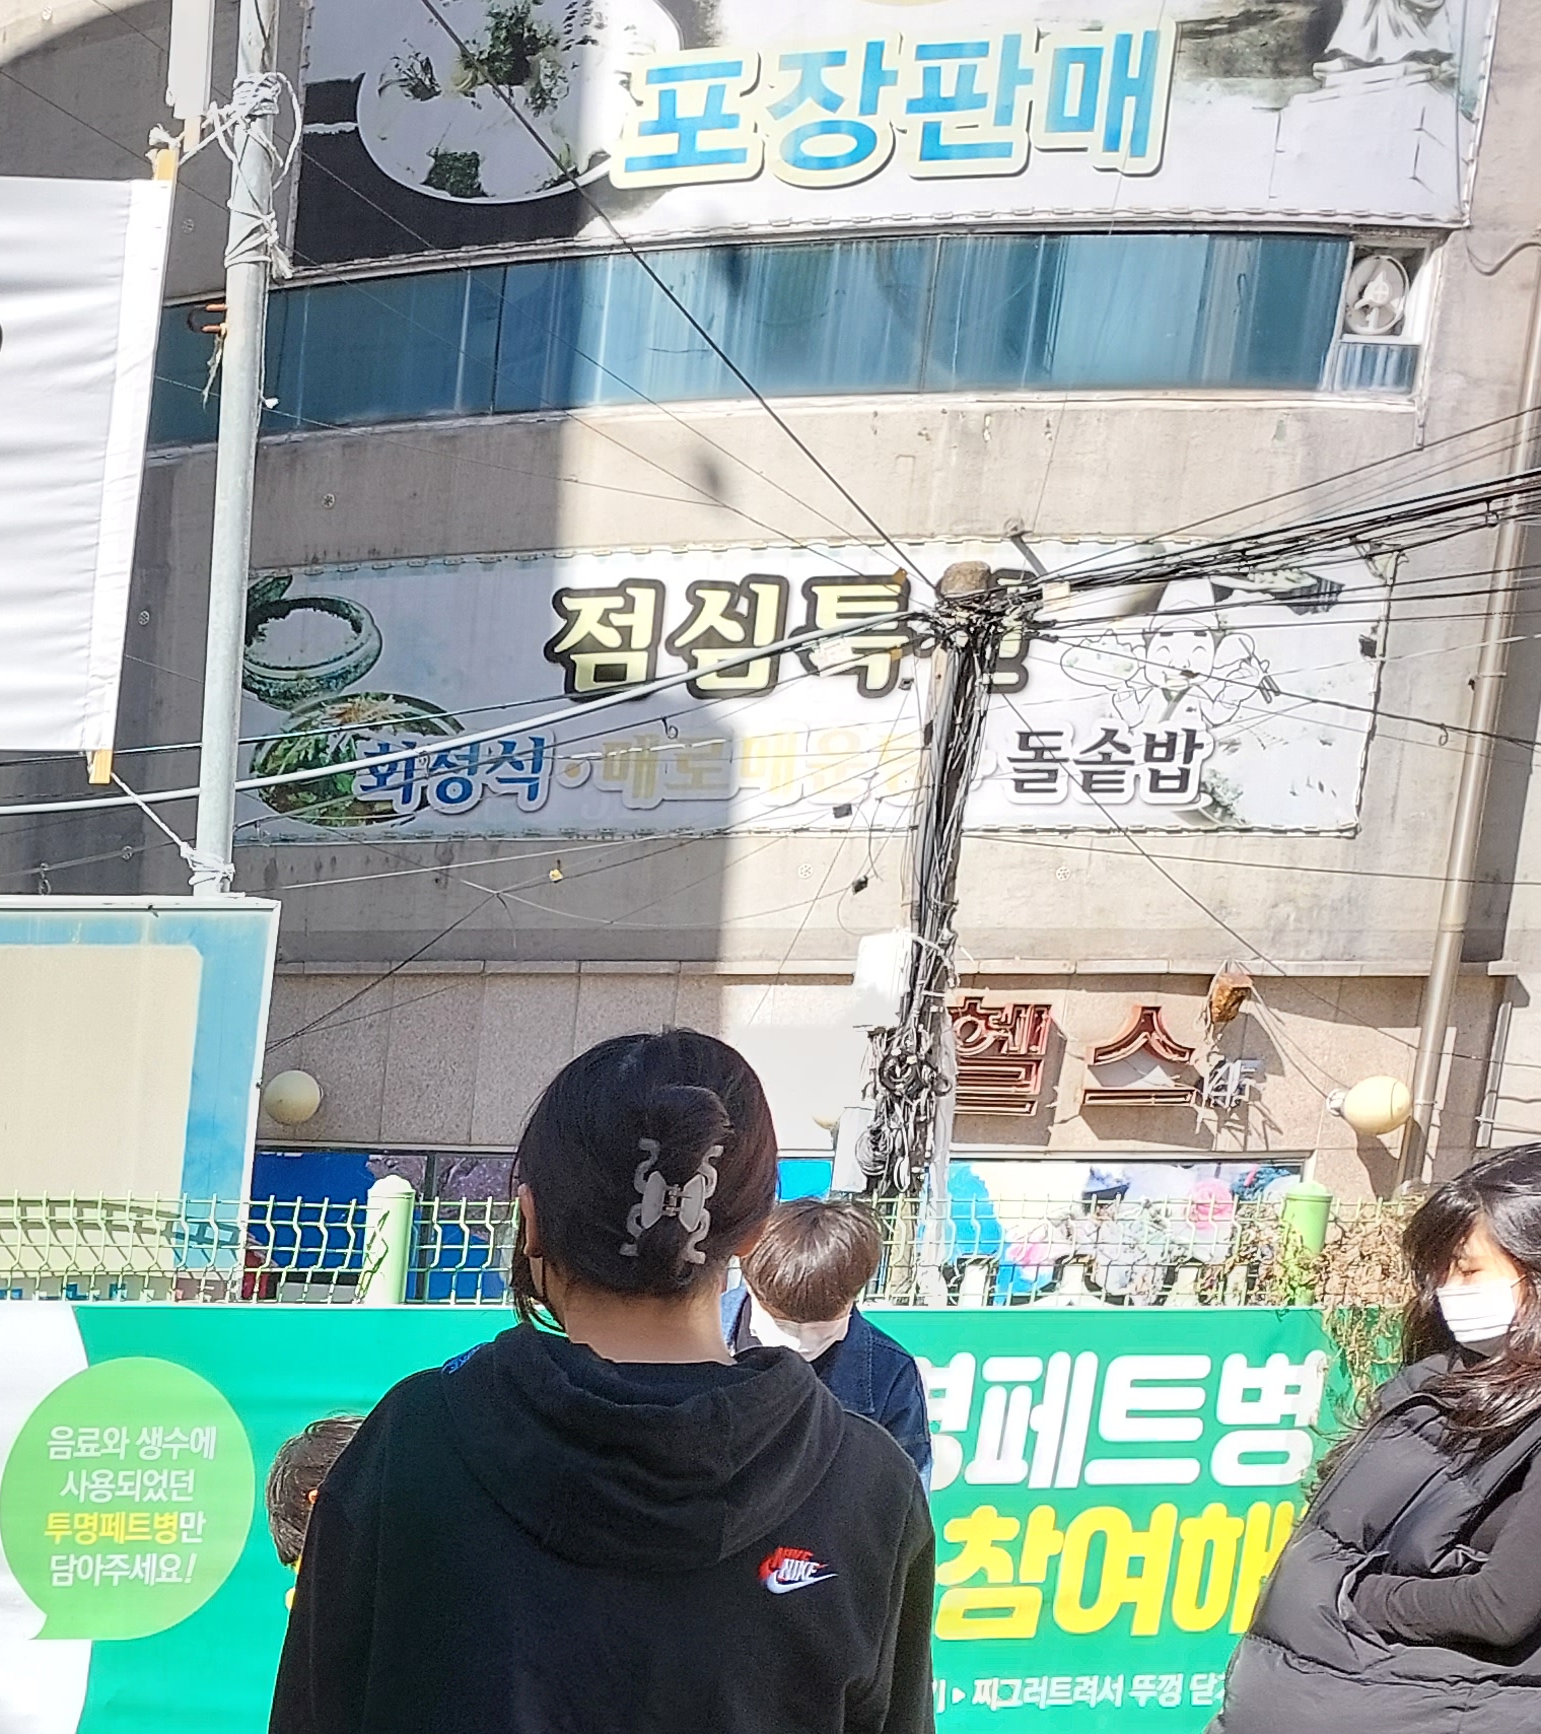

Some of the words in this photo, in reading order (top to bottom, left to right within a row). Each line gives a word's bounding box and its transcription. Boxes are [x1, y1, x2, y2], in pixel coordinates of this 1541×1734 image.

[619, 26, 1165, 175] 포장판매
[1005, 726, 1206, 797] 돌솥밥
[46, 1425, 130, 1461] 음료와
[135, 1425, 217, 1461] 생수에
[59, 1468, 195, 1503] 사용되었던
[43, 1510, 207, 1545] 투명페트병만
[49, 1552, 198, 1587] 담아주세요!
[1128, 1673, 1184, 1709] 뚜껑
